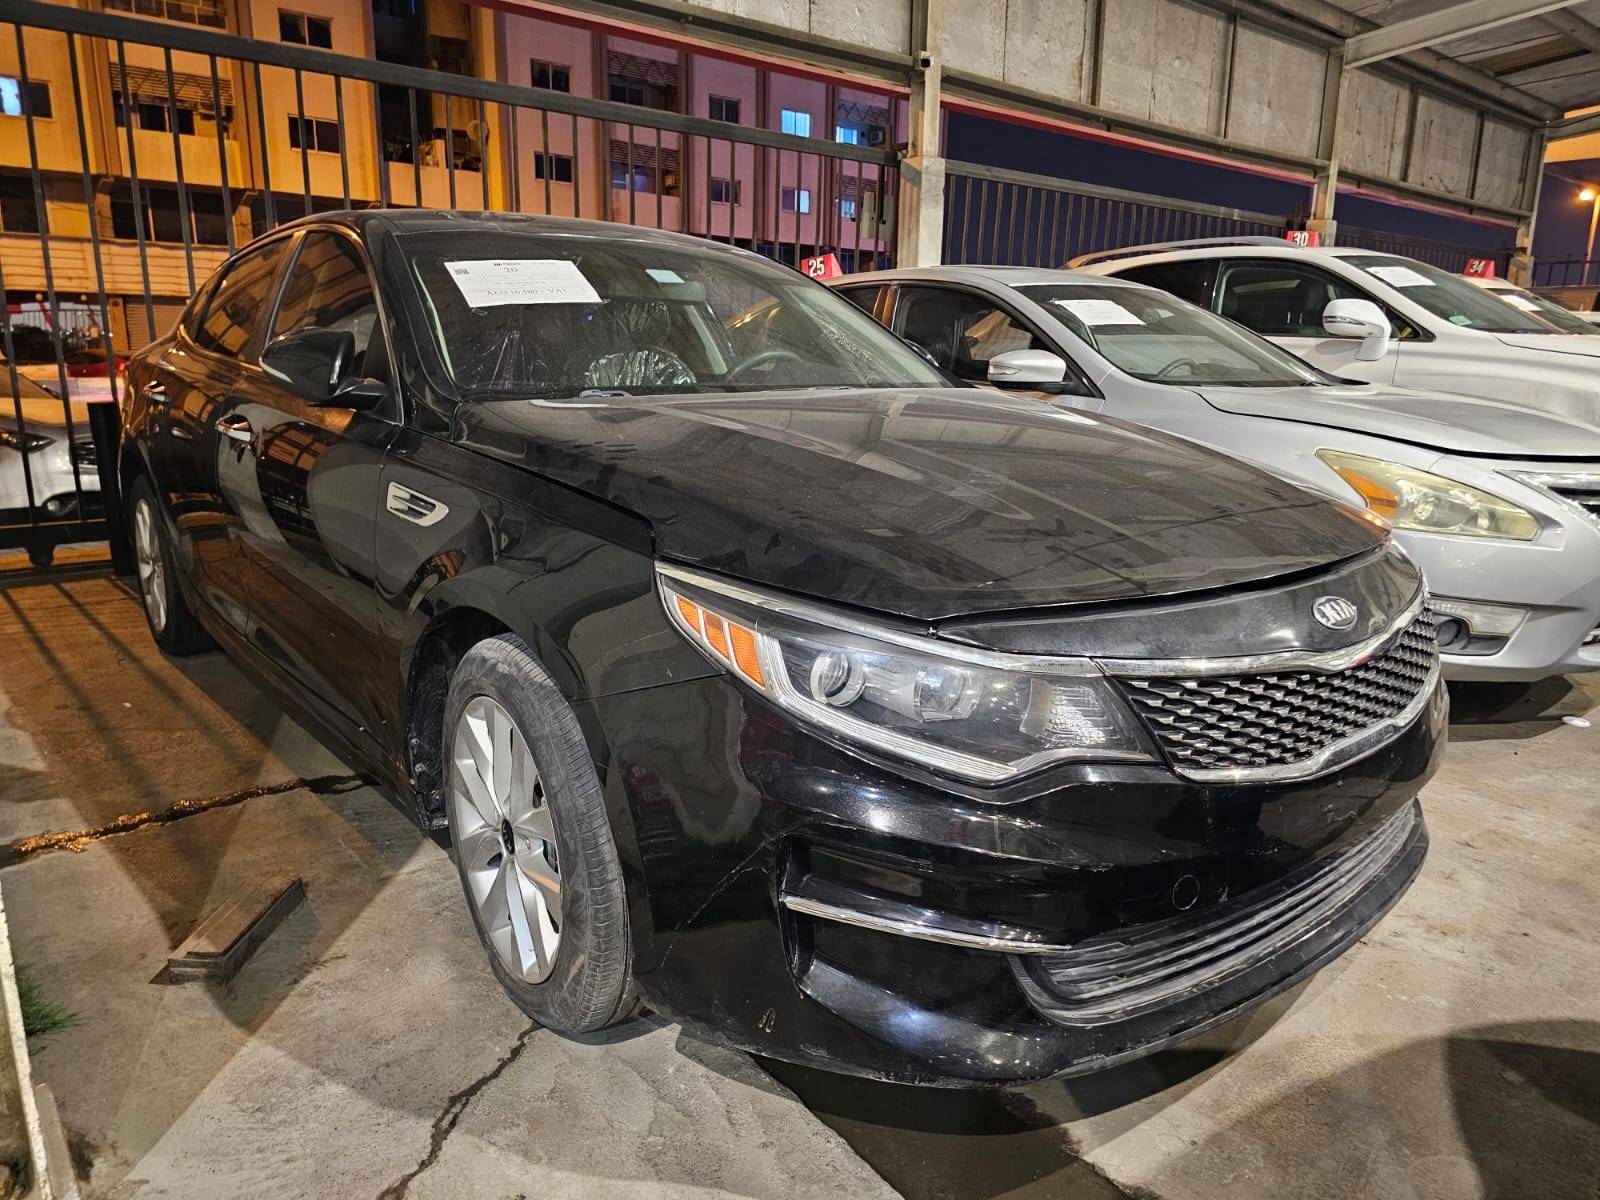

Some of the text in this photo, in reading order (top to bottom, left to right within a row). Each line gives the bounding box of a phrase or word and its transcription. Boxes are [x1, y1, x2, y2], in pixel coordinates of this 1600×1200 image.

[1293, 232, 1309, 246] 30
[808, 257, 825, 277] 25
[1470, 259, 1485, 273] 34
[1317, 599, 1355, 624] KIA
